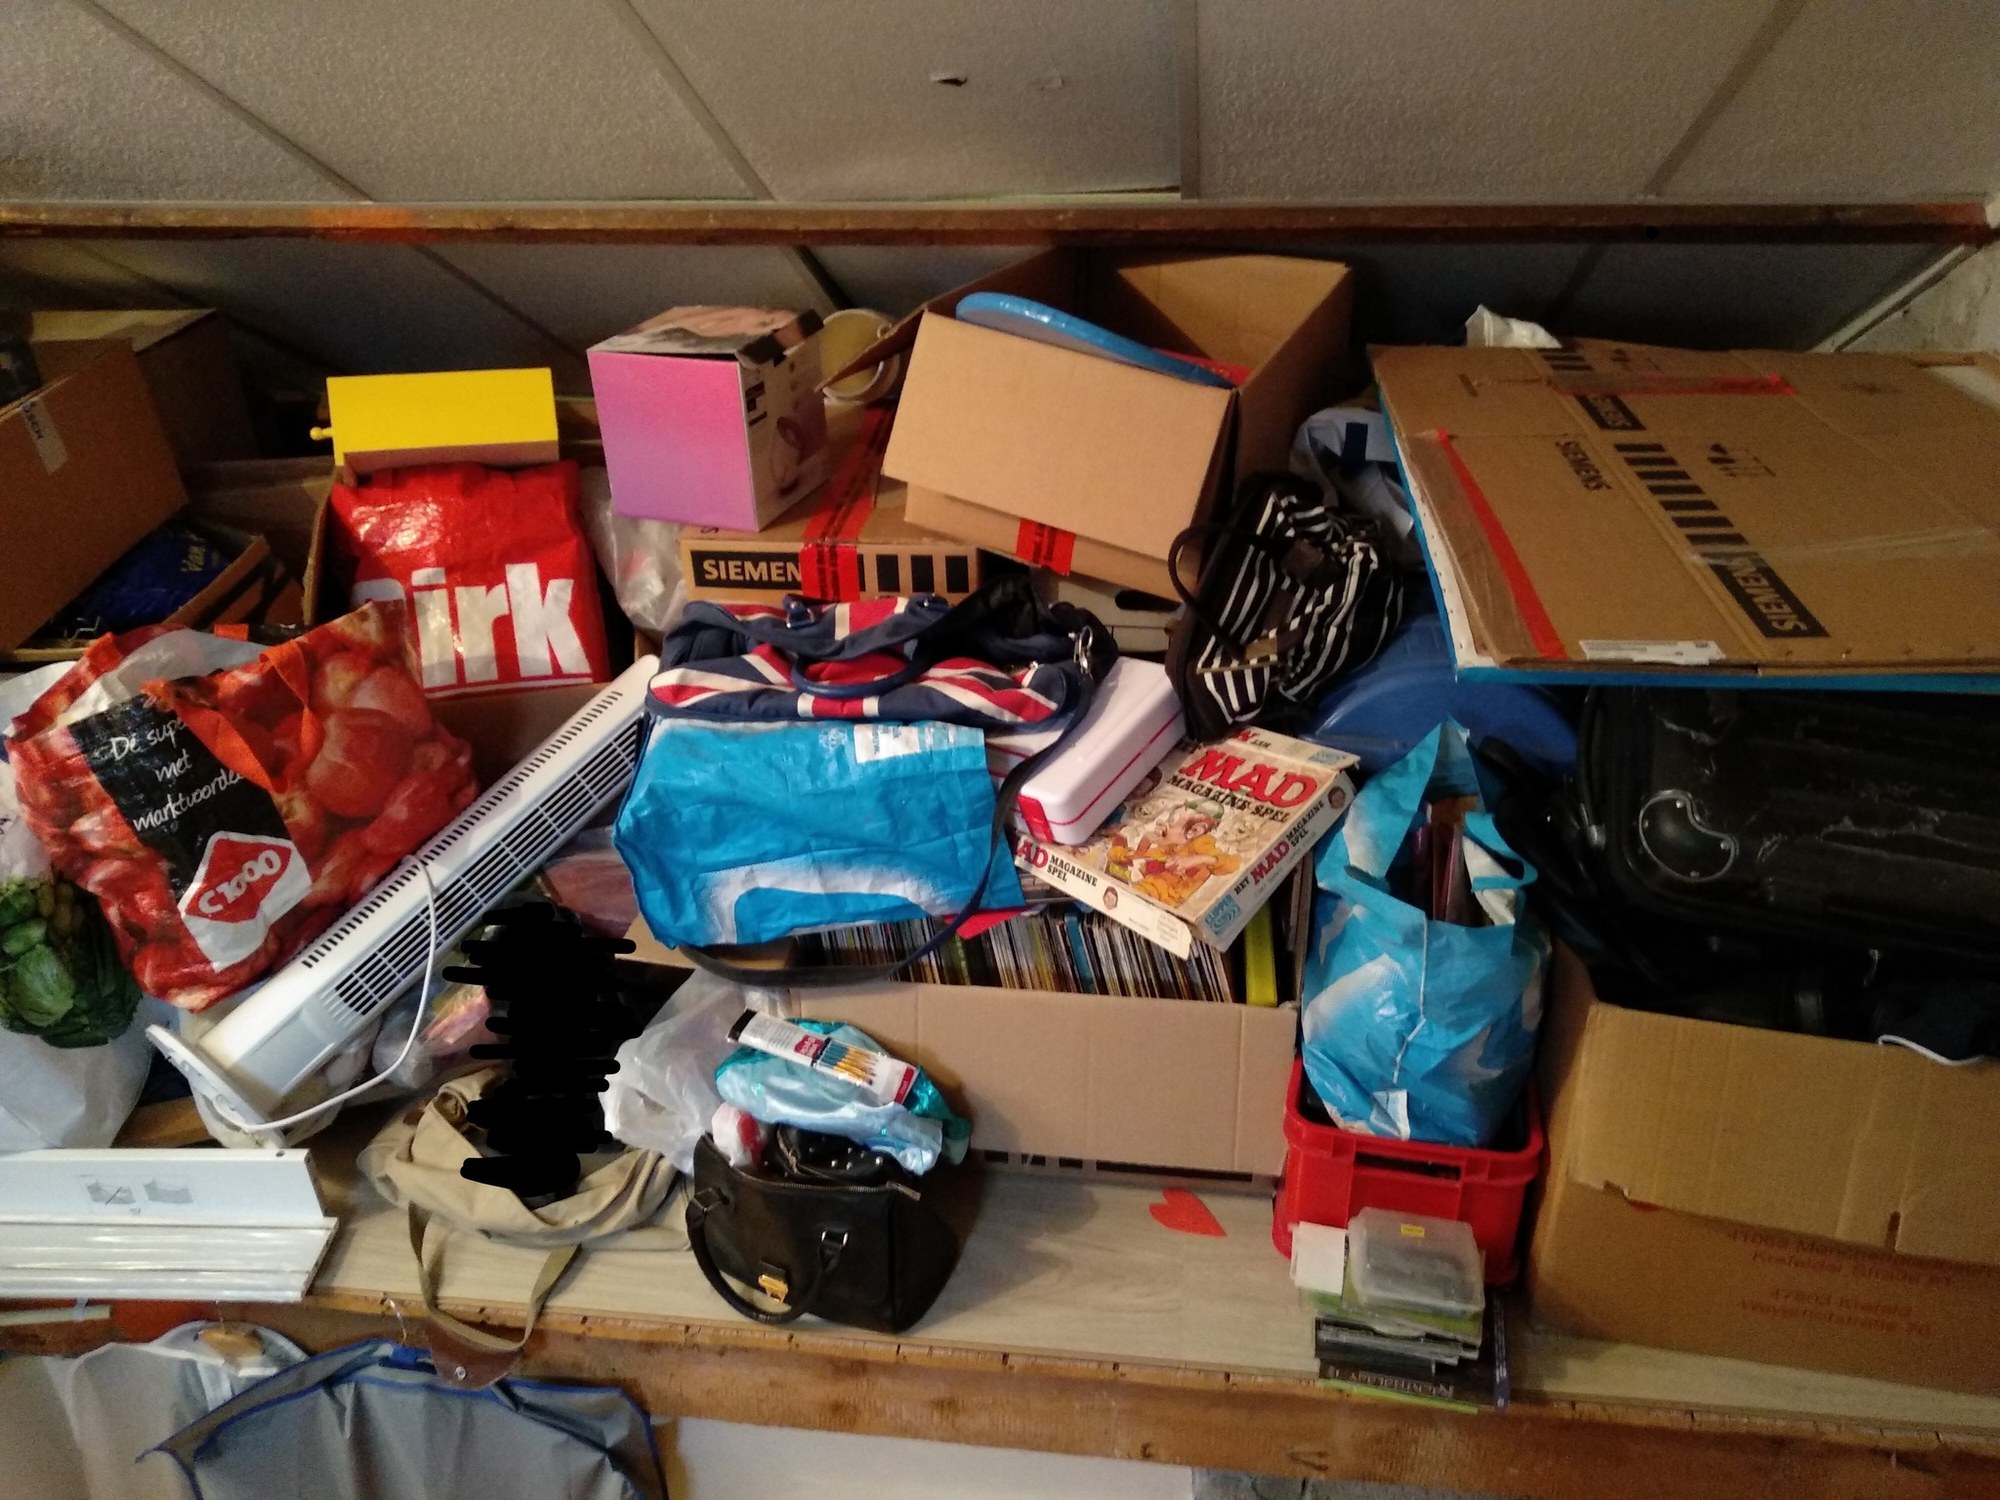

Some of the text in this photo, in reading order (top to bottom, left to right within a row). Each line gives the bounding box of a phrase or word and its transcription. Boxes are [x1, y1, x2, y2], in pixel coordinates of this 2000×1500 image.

[702, 559, 802, 583] SIEMEN
[1727, 556, 1808, 632] SIEMENS
[353, 562, 592, 689] irk
[147, 717, 188, 748] supe
[155, 748, 193, 782] met
[1178, 749, 1318, 808] MAD
[133, 767, 247, 832] marktvoorde
[1166, 775, 1292, 823] MAGAZINE SPEL
[1286, 803, 1325, 841] MAGAZINE
[1291, 829, 1309, 848] SPEL
[1015, 841, 1049, 868] AD
[1050, 854, 1098, 887] MAGAZINE
[1234, 876, 1251, 895] HET
[1250, 840, 1290, 885] MAD
[198, 849, 282, 914] C1000
[1047, 866, 1068, 883] SPEL
